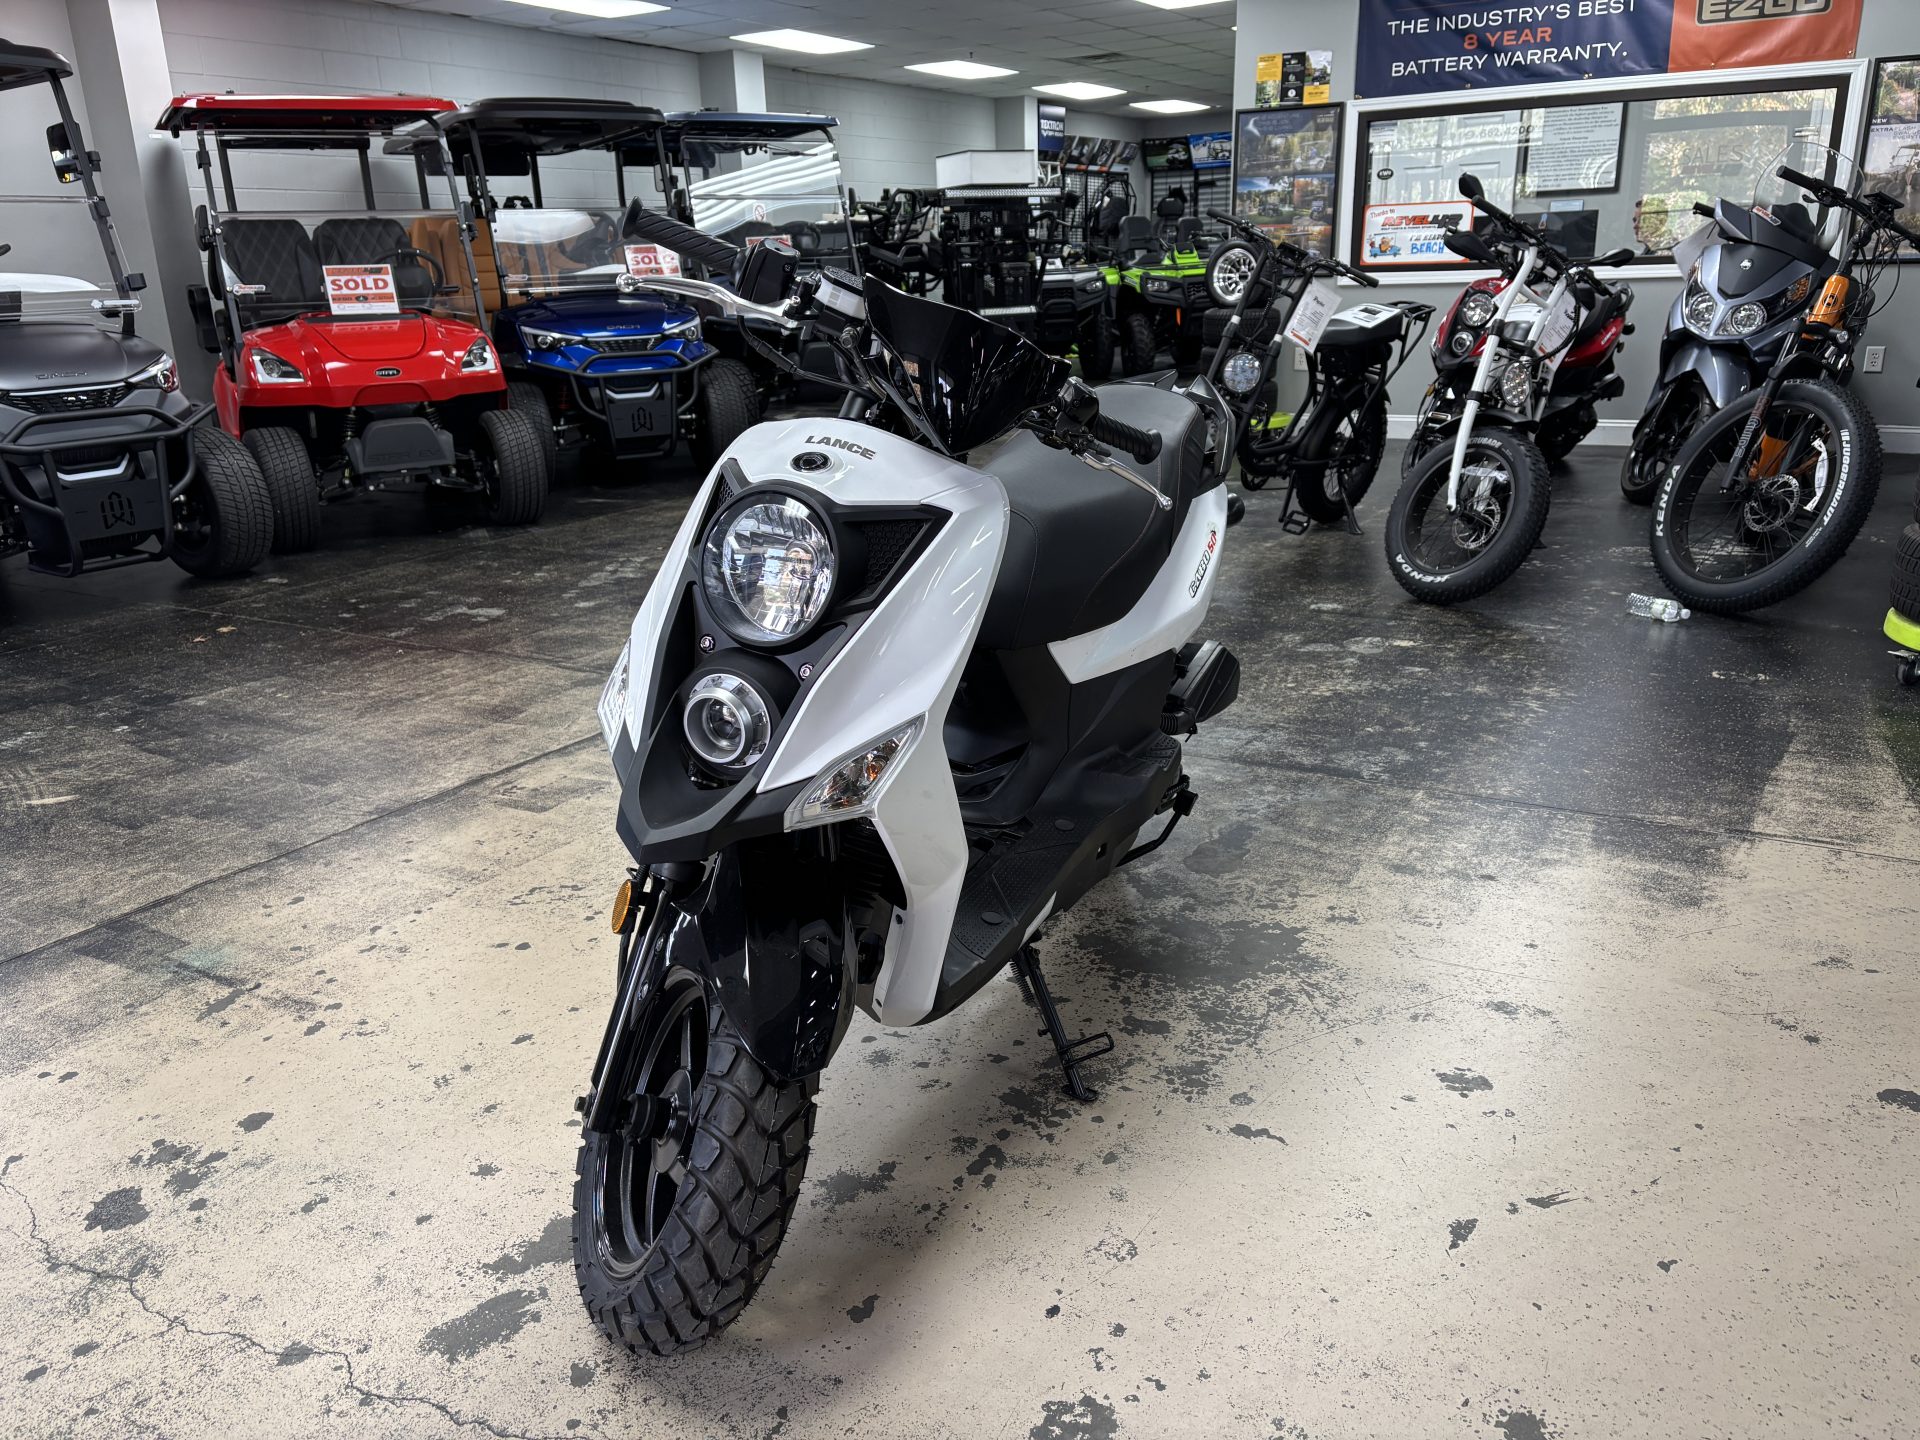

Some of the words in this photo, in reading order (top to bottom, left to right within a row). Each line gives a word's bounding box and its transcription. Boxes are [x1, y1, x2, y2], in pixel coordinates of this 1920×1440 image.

[1388, 18, 1430, 36] THE
[1436, 2, 1571, 32] INDUSTRY'S
[1578, 0, 1635, 17] BEST
[1463, 34, 1478, 50] 8
[1486, 27, 1552, 48] YEAR
[1391, 54, 1488, 77] BATTERY
[1493, 41, 1628, 68] WARRANTY.
[1411, 241, 1445, 254] BEACH
[330, 277, 389, 291] SOLD
[804, 435, 876, 460] LANCE
[1823, 441, 1851, 526] JUGGERNAUT
[1656, 465, 1681, 536] KENDA
[1207, 531, 1217, 554] 50
[1396, 553, 1451, 583] KENDA
